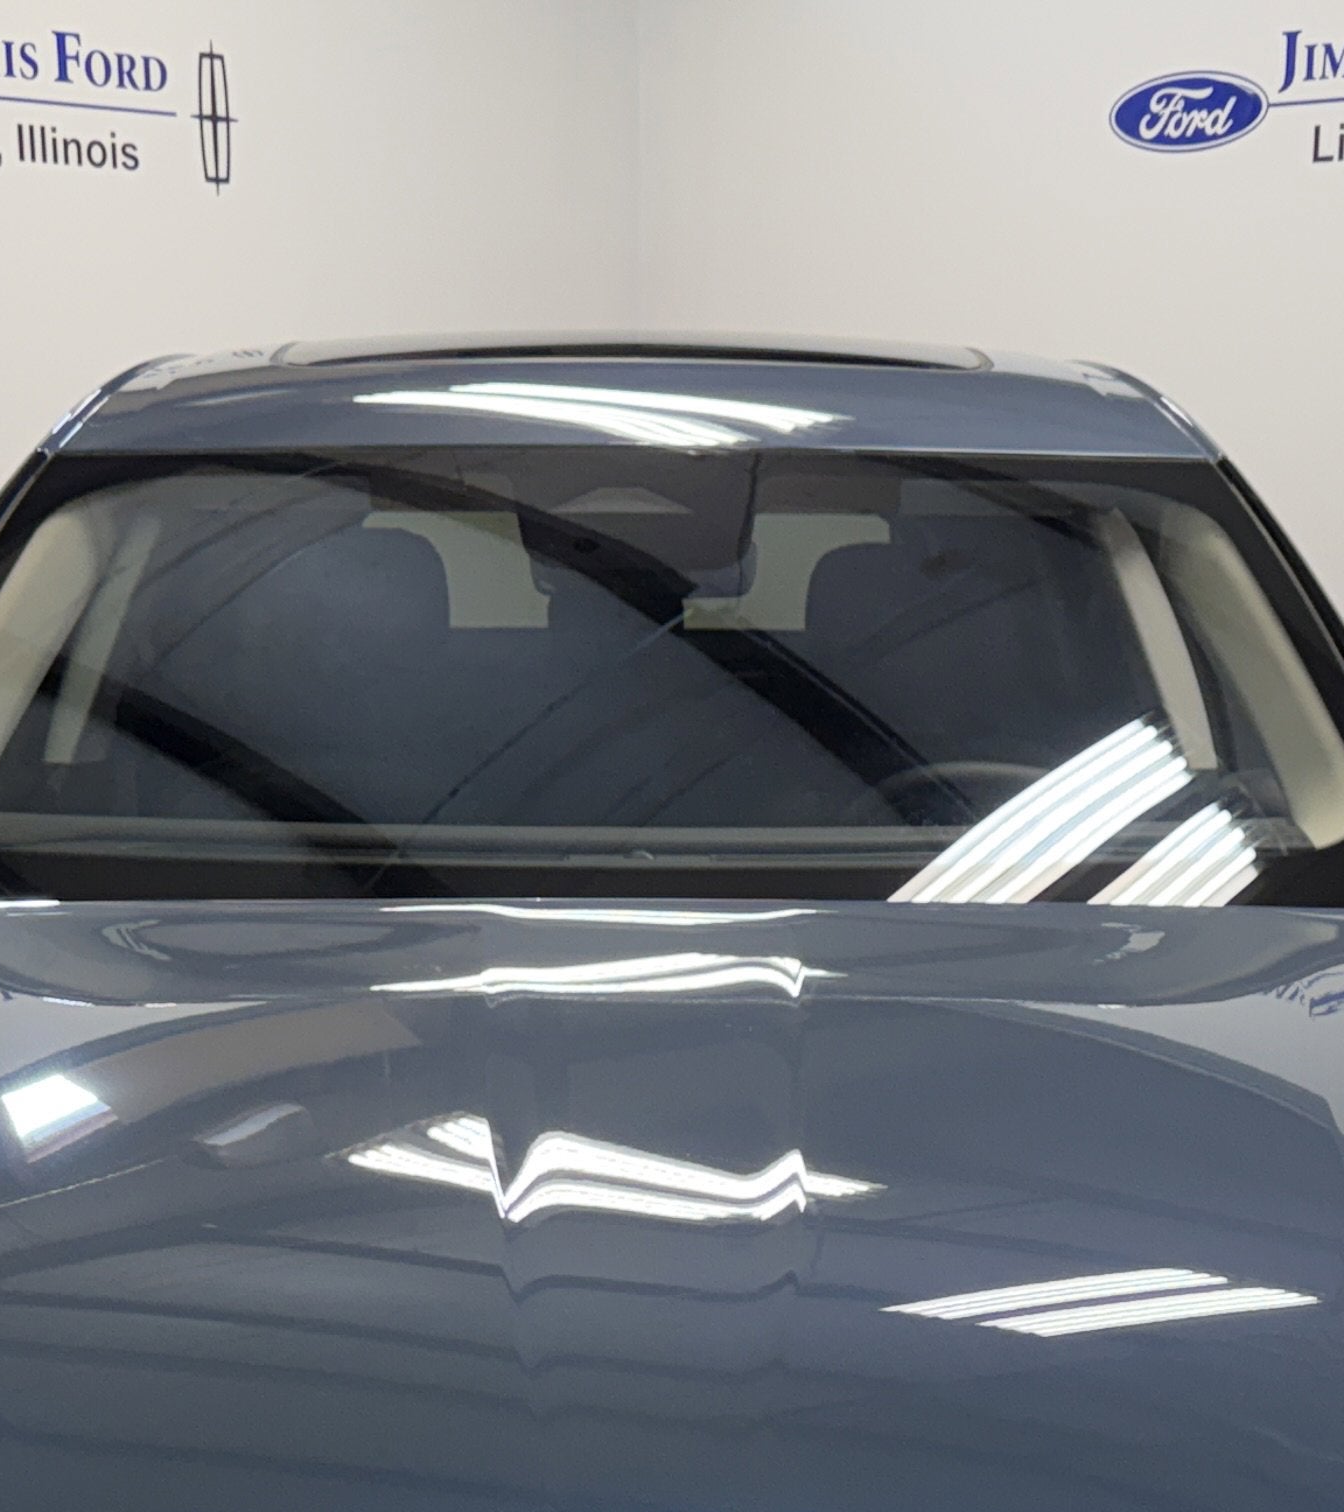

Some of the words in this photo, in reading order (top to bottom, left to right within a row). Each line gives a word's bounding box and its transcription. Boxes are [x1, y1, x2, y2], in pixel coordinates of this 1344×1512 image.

[53, 30, 168, 92] FORD
[1138, 86, 1237, 140] Ford
[17, 123, 140, 171] Illinois
